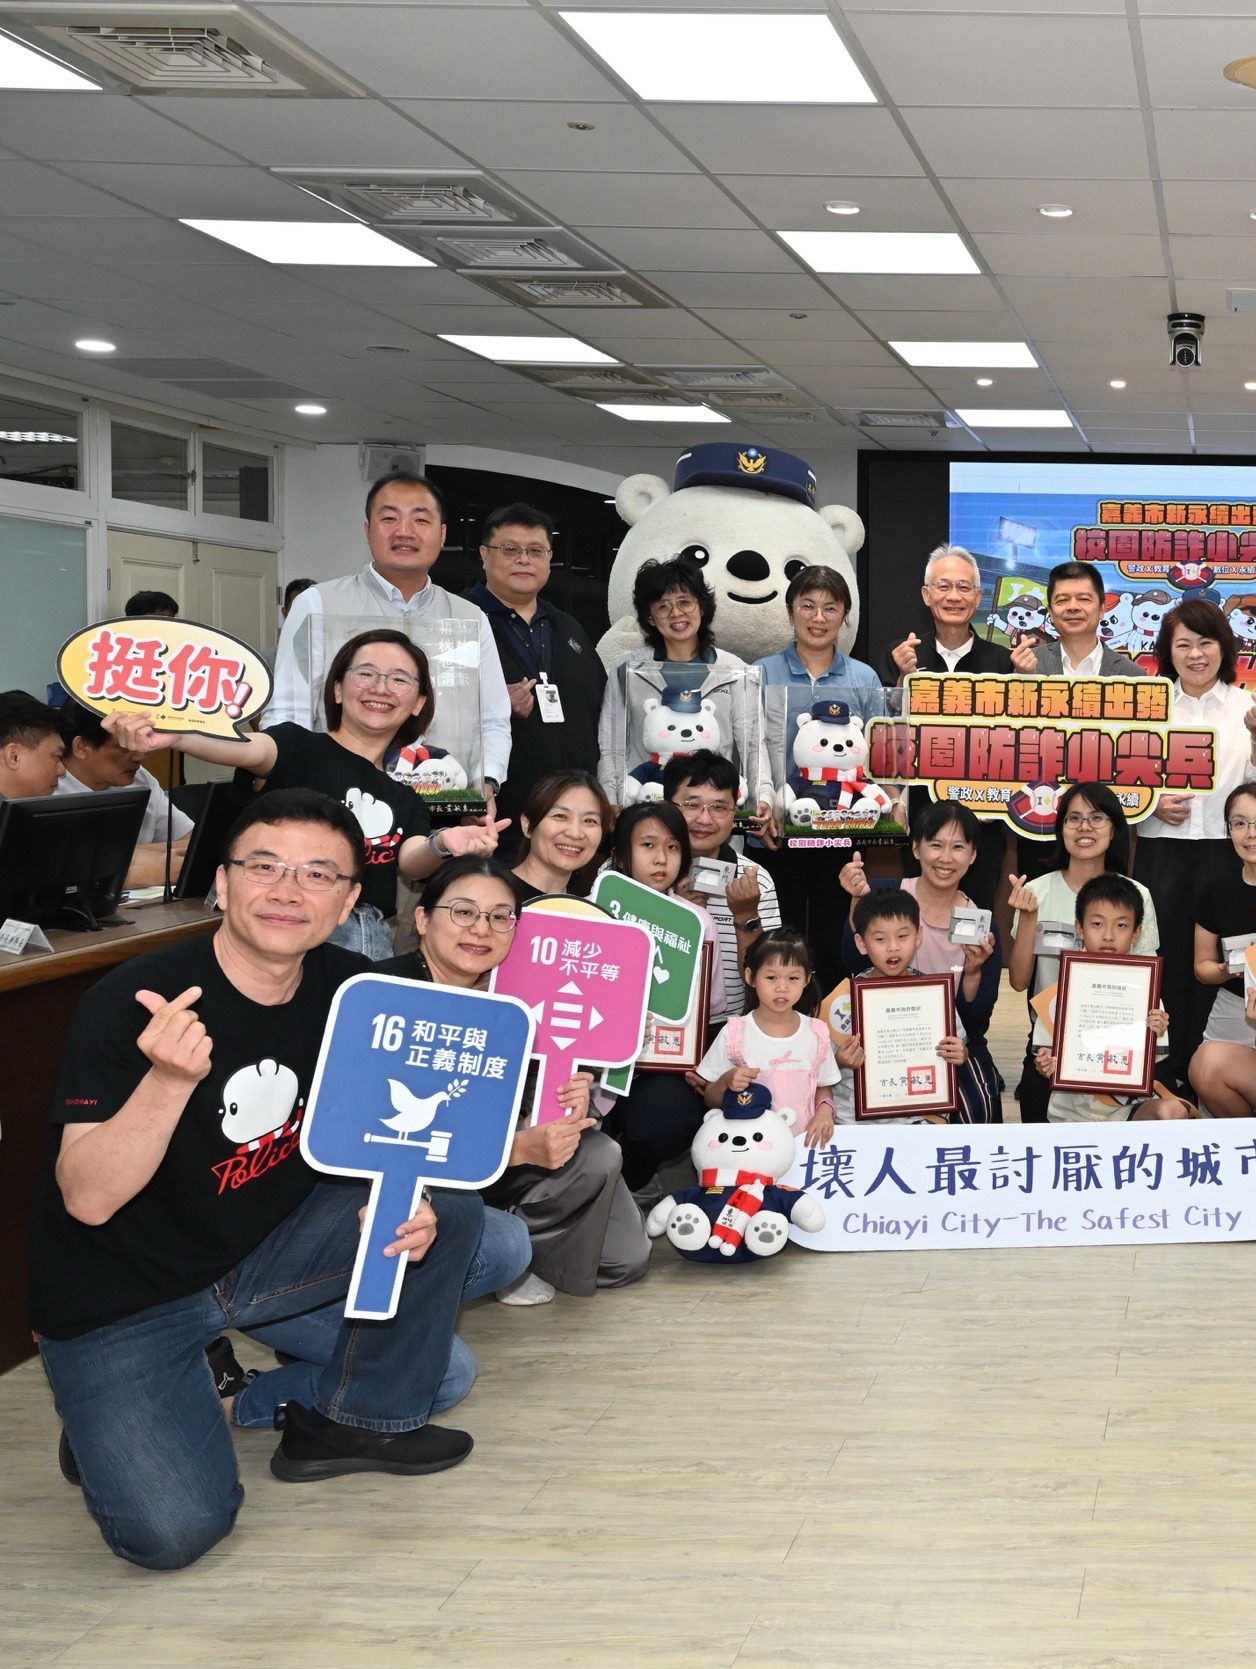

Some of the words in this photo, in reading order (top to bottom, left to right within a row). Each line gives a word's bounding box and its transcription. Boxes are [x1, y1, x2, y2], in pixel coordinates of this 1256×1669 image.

[909, 677, 1168, 721] 嘉義市新永續出發
[868, 722, 1216, 788] 校園防詐小尖兵
[529, 936, 555, 966] 10
[562, 937, 602, 959] 減少
[559, 957, 620, 983] 不平等
[371, 1013, 405, 1052] 16
[410, 1019, 487, 1050] 和平與
[405, 1045, 508, 1079] 正義制度
[842, 1211, 929, 1239] Chiayi
[1082, 1206, 1168, 1232] Safest
[1184, 1204, 1242, 1232] City
